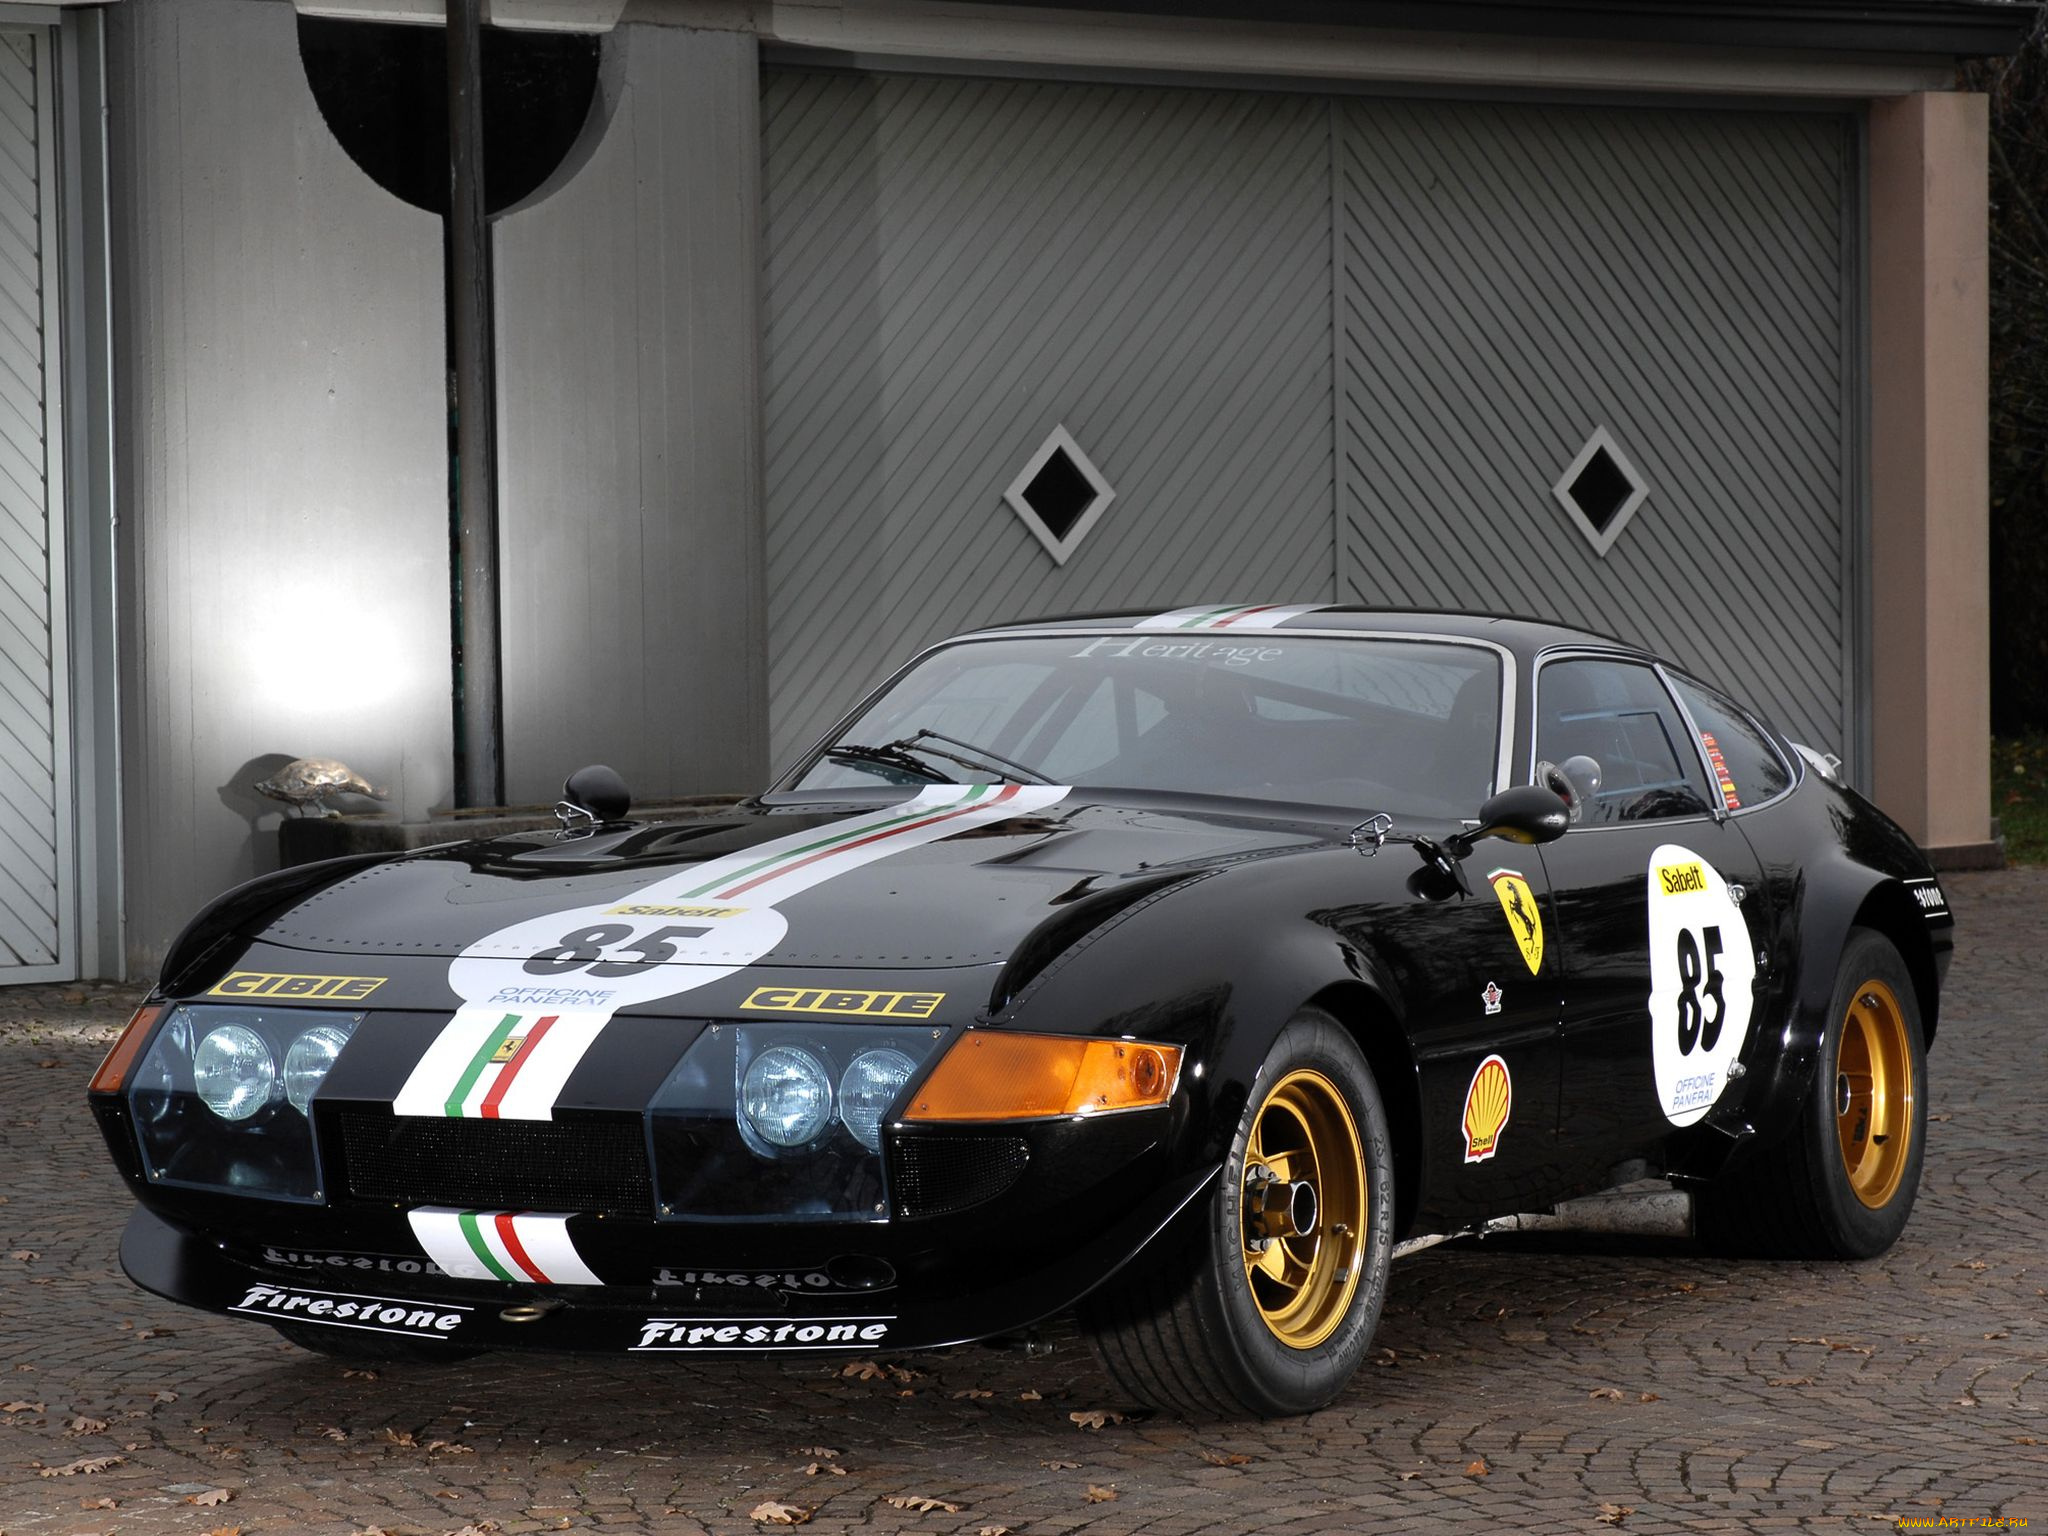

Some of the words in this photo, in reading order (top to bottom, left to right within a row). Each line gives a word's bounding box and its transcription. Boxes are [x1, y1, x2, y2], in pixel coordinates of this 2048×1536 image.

[1069, 636, 1283, 667] Heritage
[1662, 866, 1703, 893] Sabelt
[618, 905, 733, 917] Sabelt
[523, 923, 714, 978] 85
[219, 975, 377, 997] CIBIE
[499, 986, 617, 998] OFFICINE
[1676, 925, 1726, 1056] 85
[488, 995, 607, 1006] PANERAI
[751, 990, 939, 1015] CIBIE
[1676, 1072, 1715, 1094] OFFICINE
[1673, 1087, 1712, 1110] PANERAI
[1472, 1134, 1493, 1148] Shell
[237, 1286, 462, 1331] Firestone
[637, 1322, 889, 1347] Firestone
